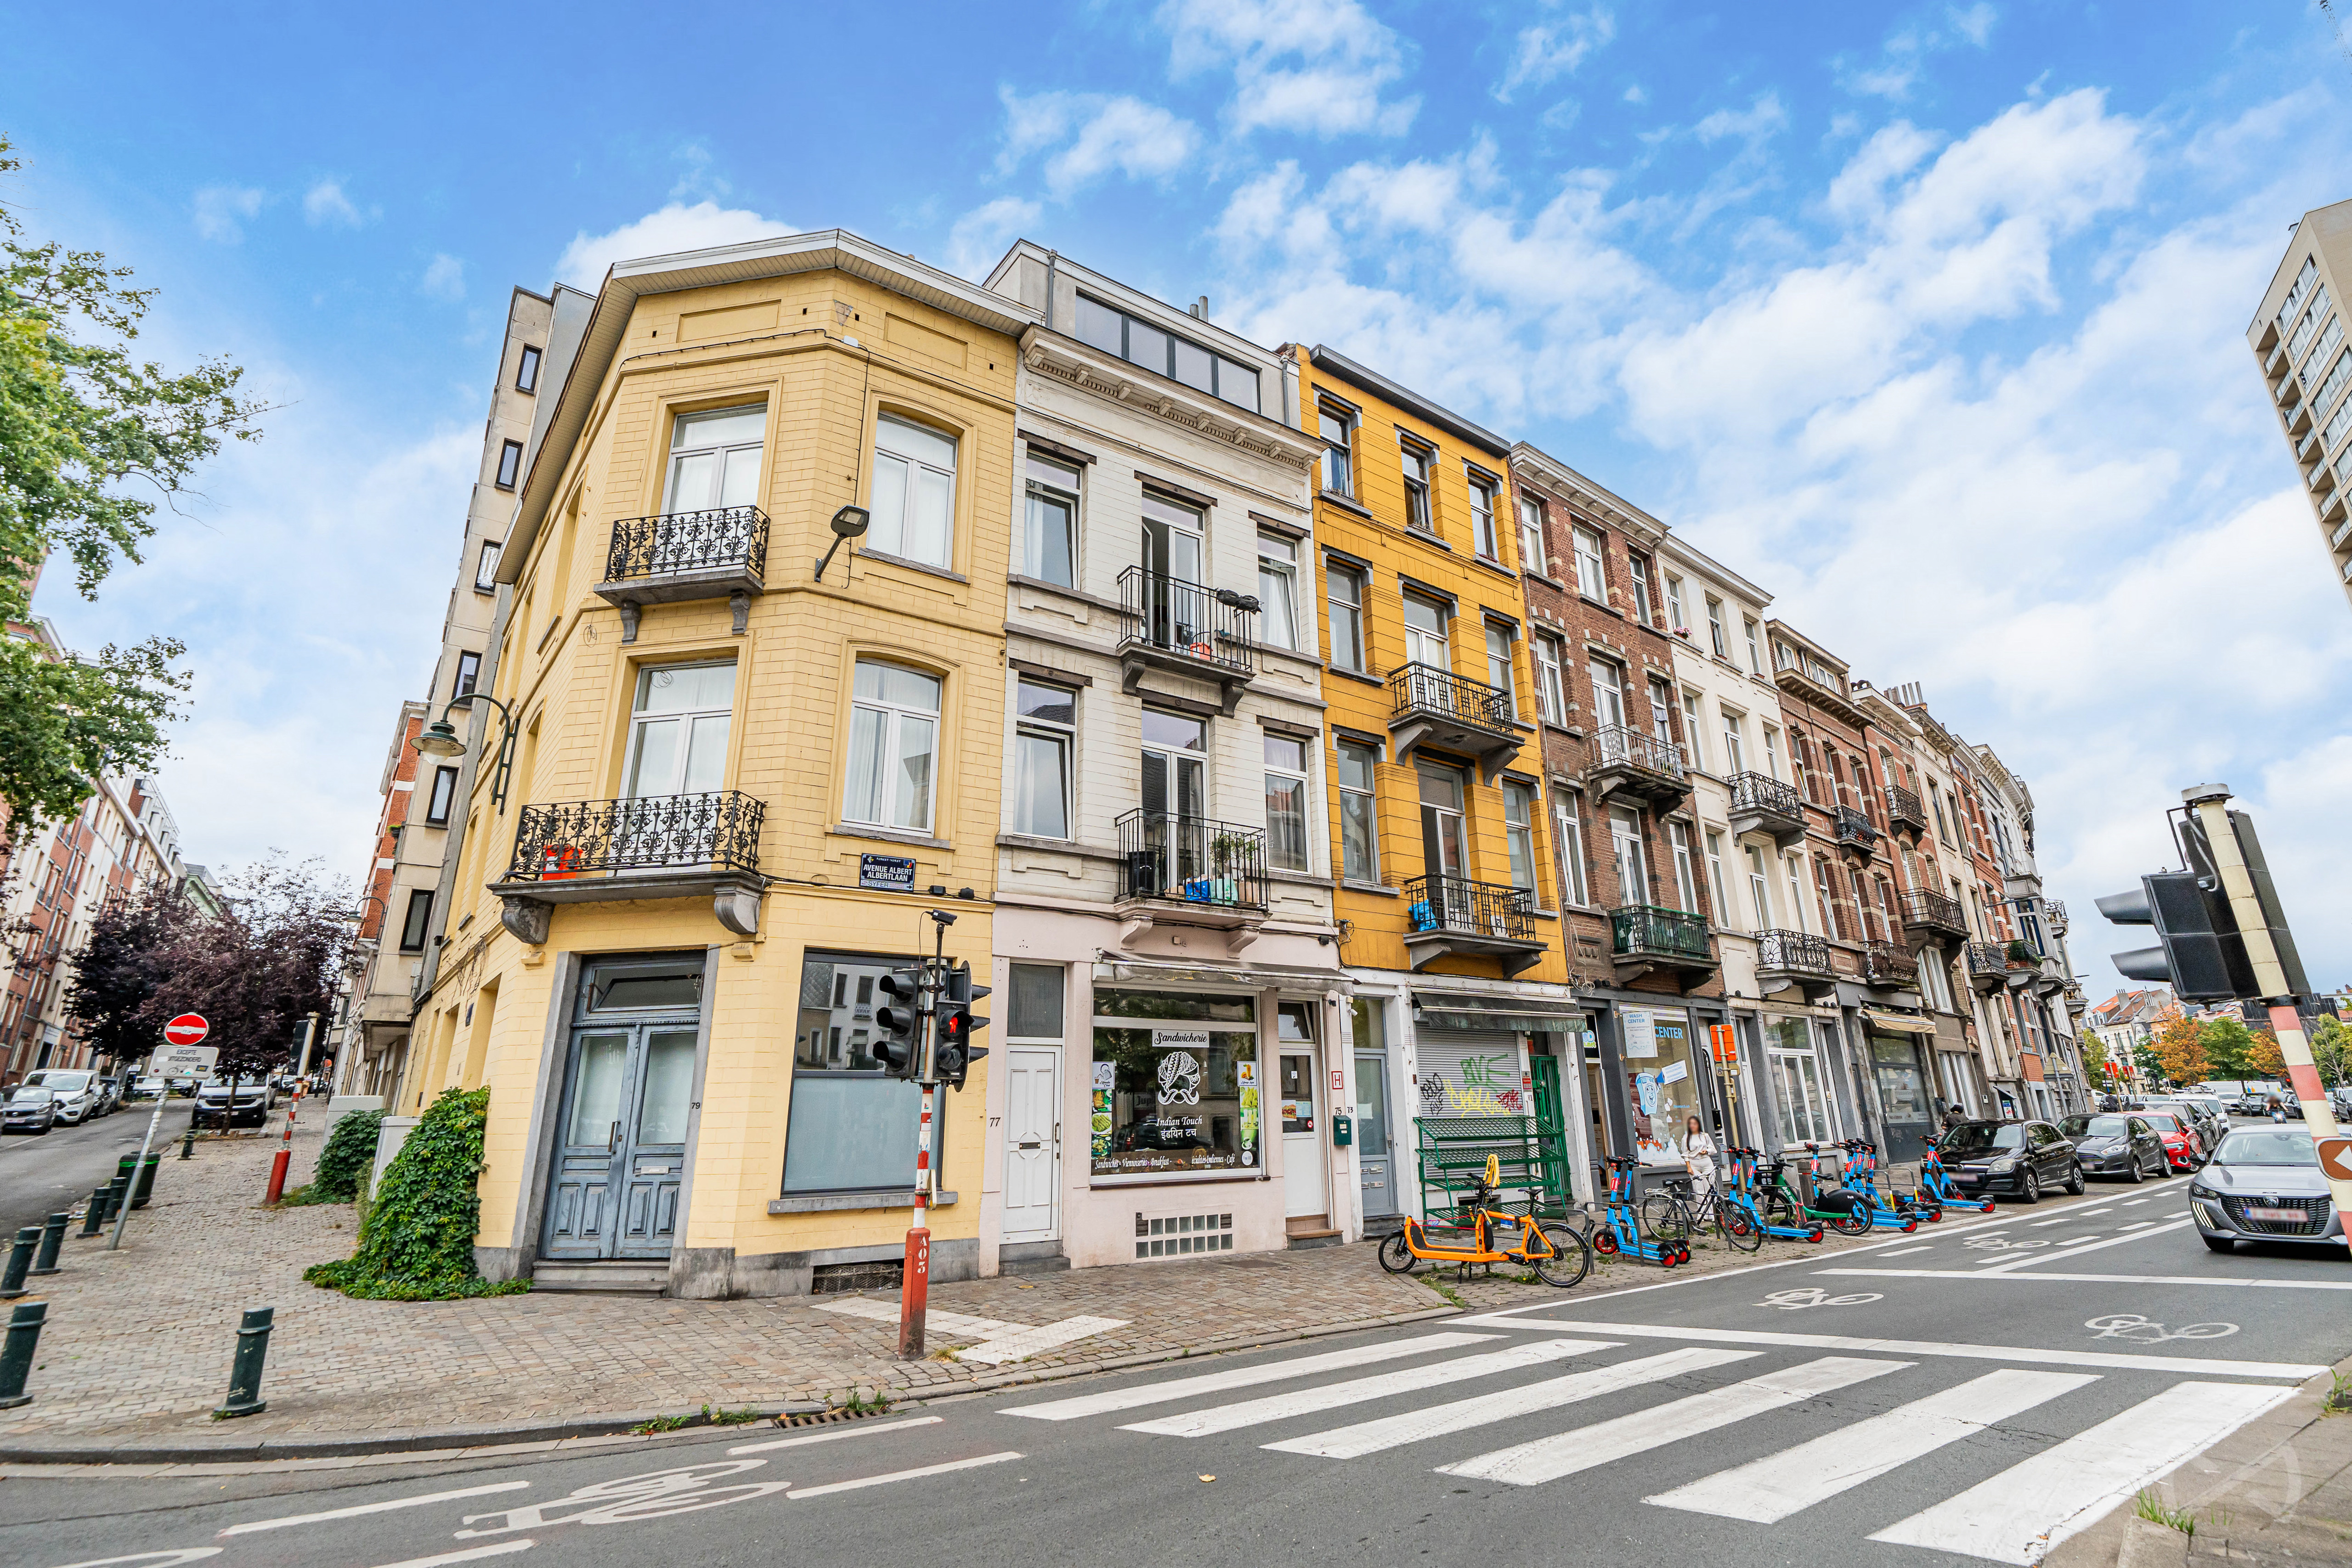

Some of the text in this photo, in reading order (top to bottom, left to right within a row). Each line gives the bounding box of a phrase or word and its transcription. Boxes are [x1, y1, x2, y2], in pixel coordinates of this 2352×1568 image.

[863, 864, 913, 875] AVENUE ALBERT
[867, 871, 908, 881] ALBERTLAAN
[1655, 1026, 1684, 1039] CENTER
[1154, 1032, 1208, 1045] Sandwicherie
[1334, 1074, 1341, 1086] H
[1334, 1107, 1342, 1115] 75
[990, 1117, 1001, 1128] 77
[1156, 1115, 1203, 1126] Indian Touch
[1095, 1156, 1170, 1169] Sandwiches Viennoiseries Breakfast
[1207, 1153, 1224, 1164] Indiennes
[1227, 1153, 1235, 1166] Café
[1782, 1186, 1791, 1196] Bolt
